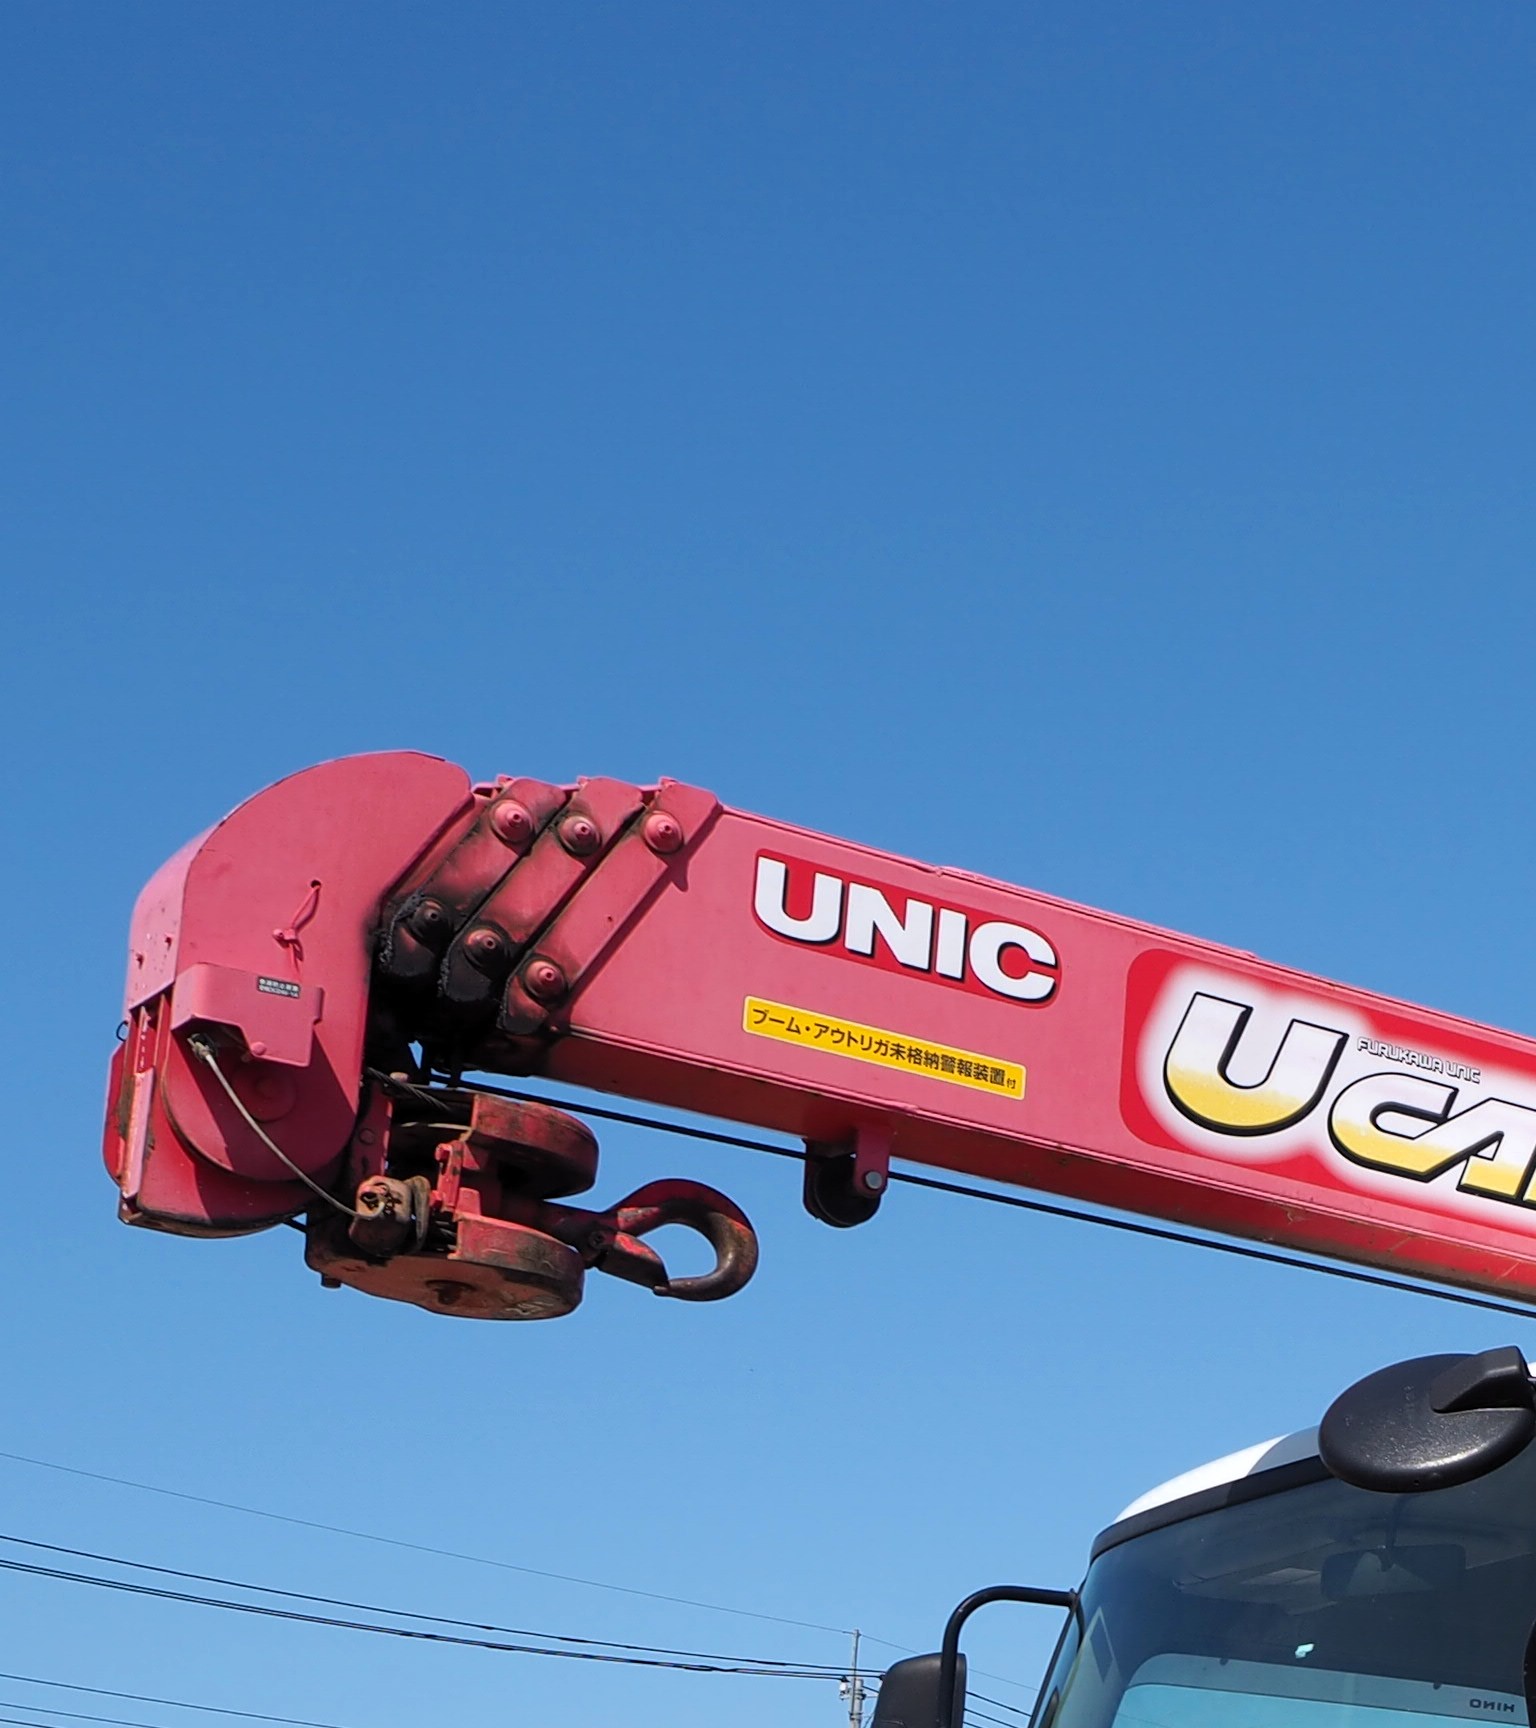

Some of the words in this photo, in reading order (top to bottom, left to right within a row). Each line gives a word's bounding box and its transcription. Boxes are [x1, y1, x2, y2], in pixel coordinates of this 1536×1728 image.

[754, 856, 1058, 1004] UNIC
[1357, 1036, 1444, 1073] FURUKAWA
[1444, 1060, 1481, 1084] UNIC
